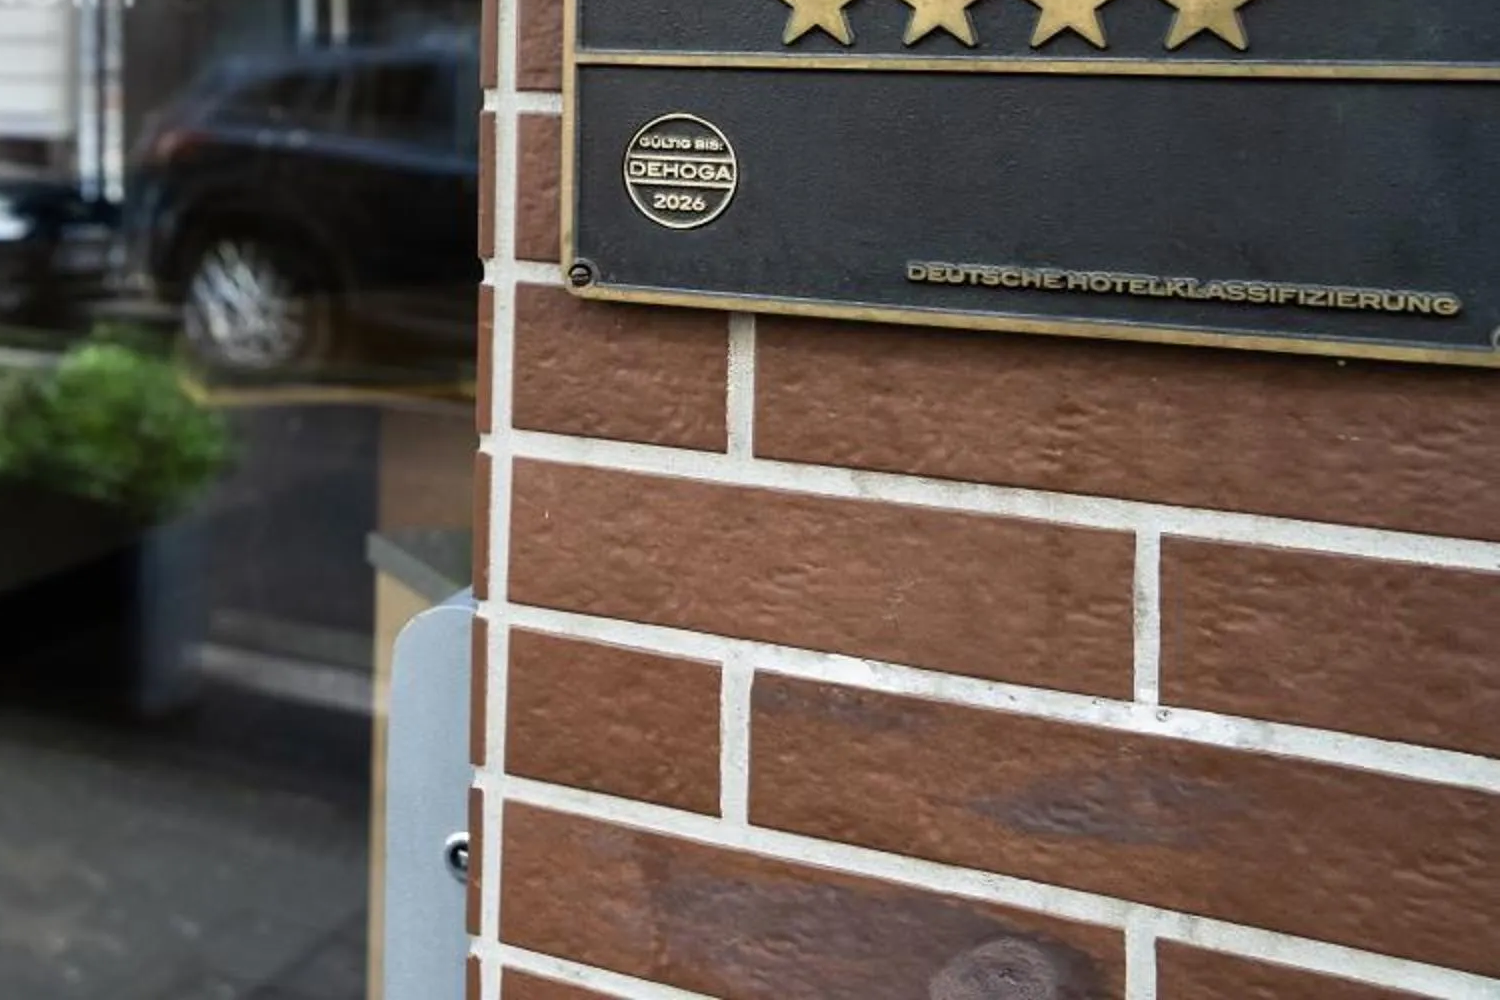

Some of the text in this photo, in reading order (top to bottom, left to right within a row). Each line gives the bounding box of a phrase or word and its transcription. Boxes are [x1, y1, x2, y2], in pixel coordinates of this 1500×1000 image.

[639, 135, 692, 149] GÜLTIG
[629, 160, 732, 180] DEHOGA
[653, 193, 706, 211] 2026
[907, 261, 1462, 316] DEUTSCHE HOTELKLASSIFIZIERUNG
